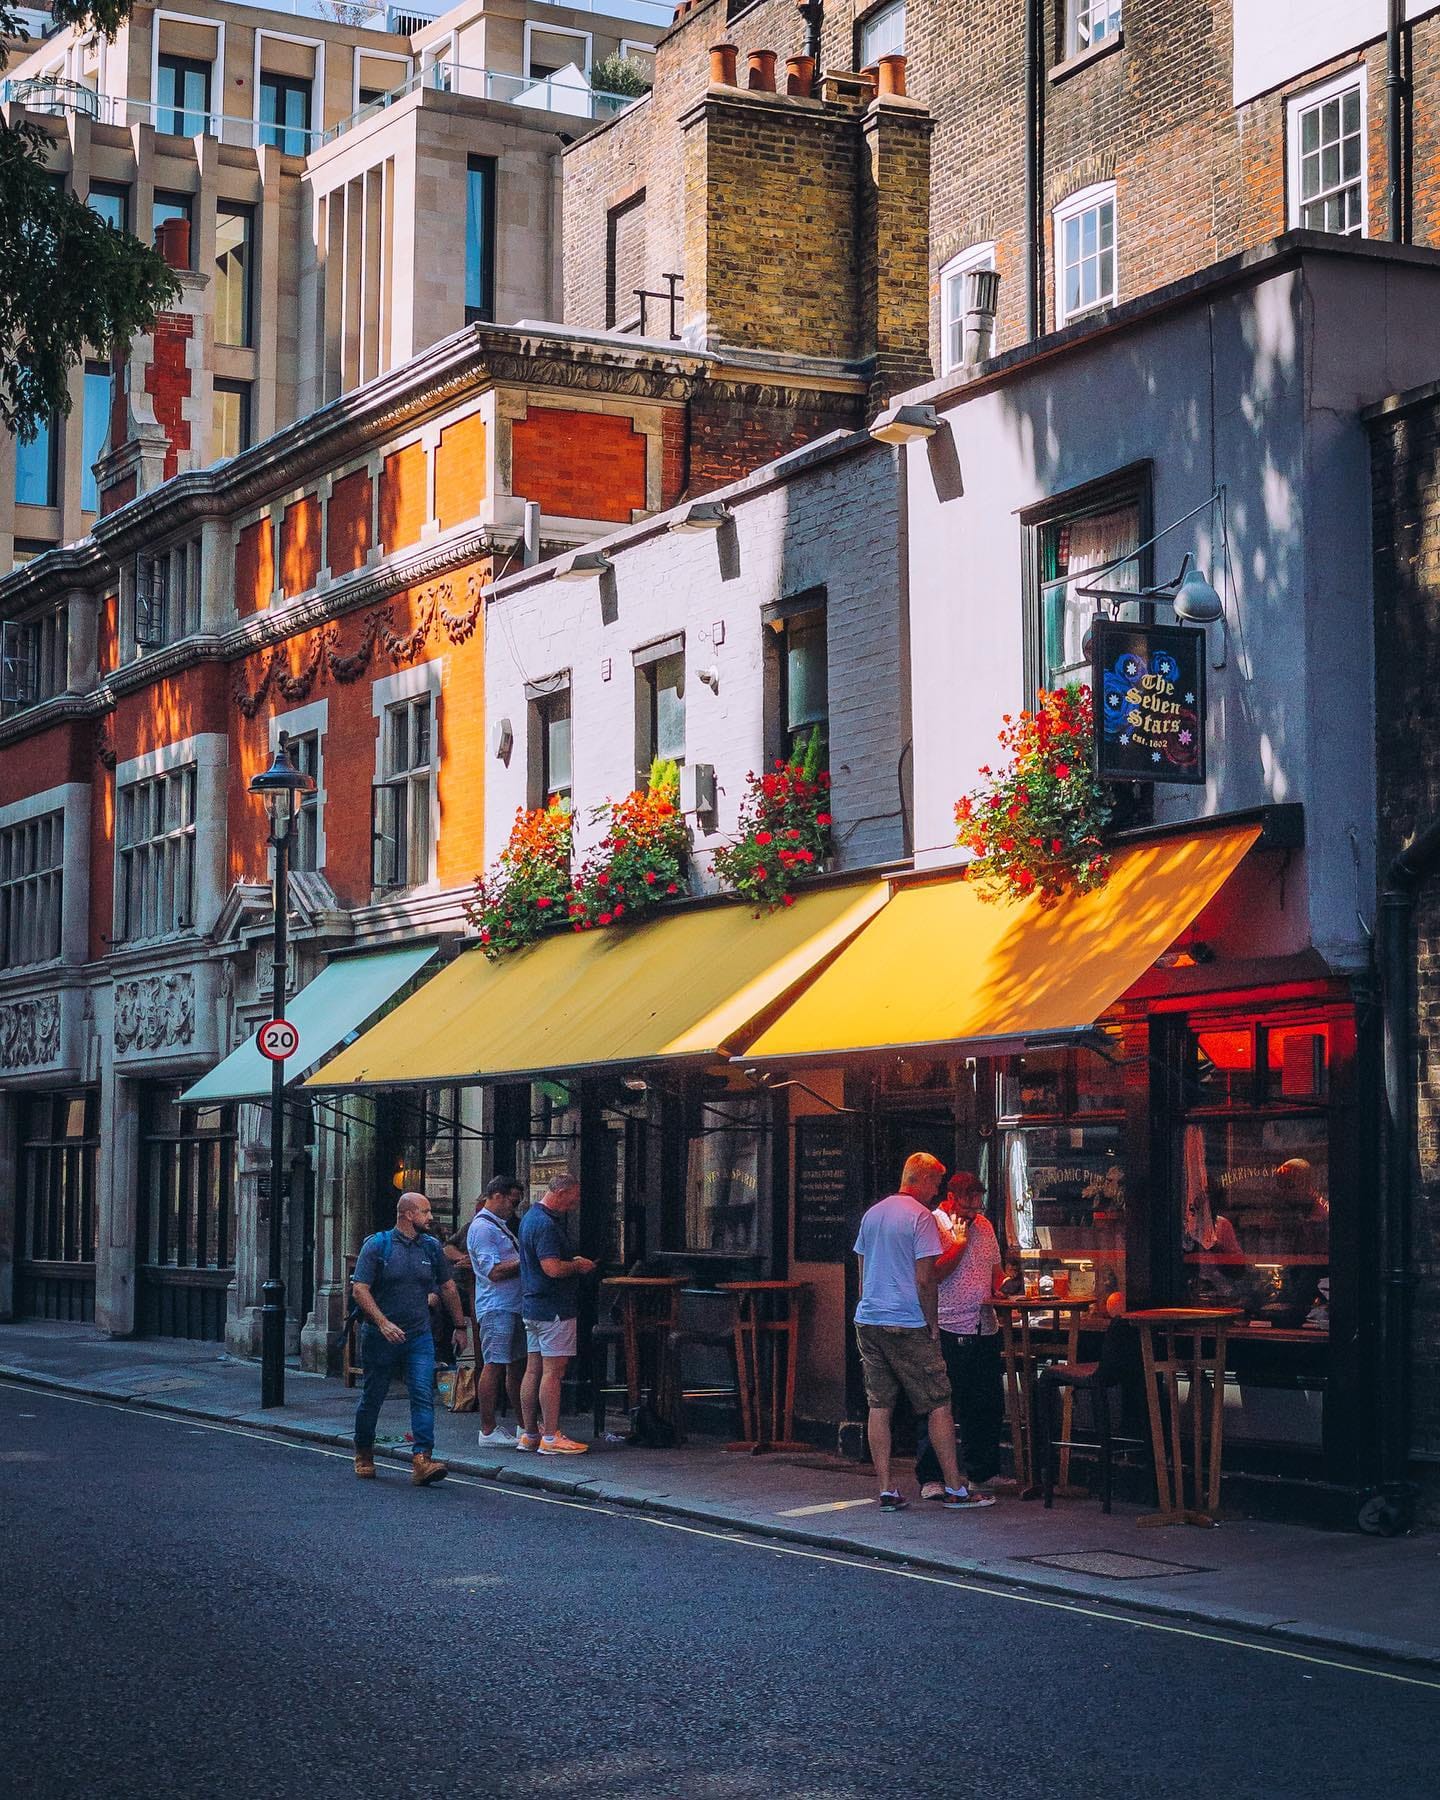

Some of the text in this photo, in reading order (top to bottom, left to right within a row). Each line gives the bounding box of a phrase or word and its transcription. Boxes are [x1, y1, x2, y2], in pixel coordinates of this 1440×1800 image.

[1141, 674, 1174, 696] The
[1125, 687, 1181, 715] Seven
[1127, 709, 1181, 734] Stars
[1149, 739, 1168, 748] 1602
[267, 1031, 294, 1048] 20
